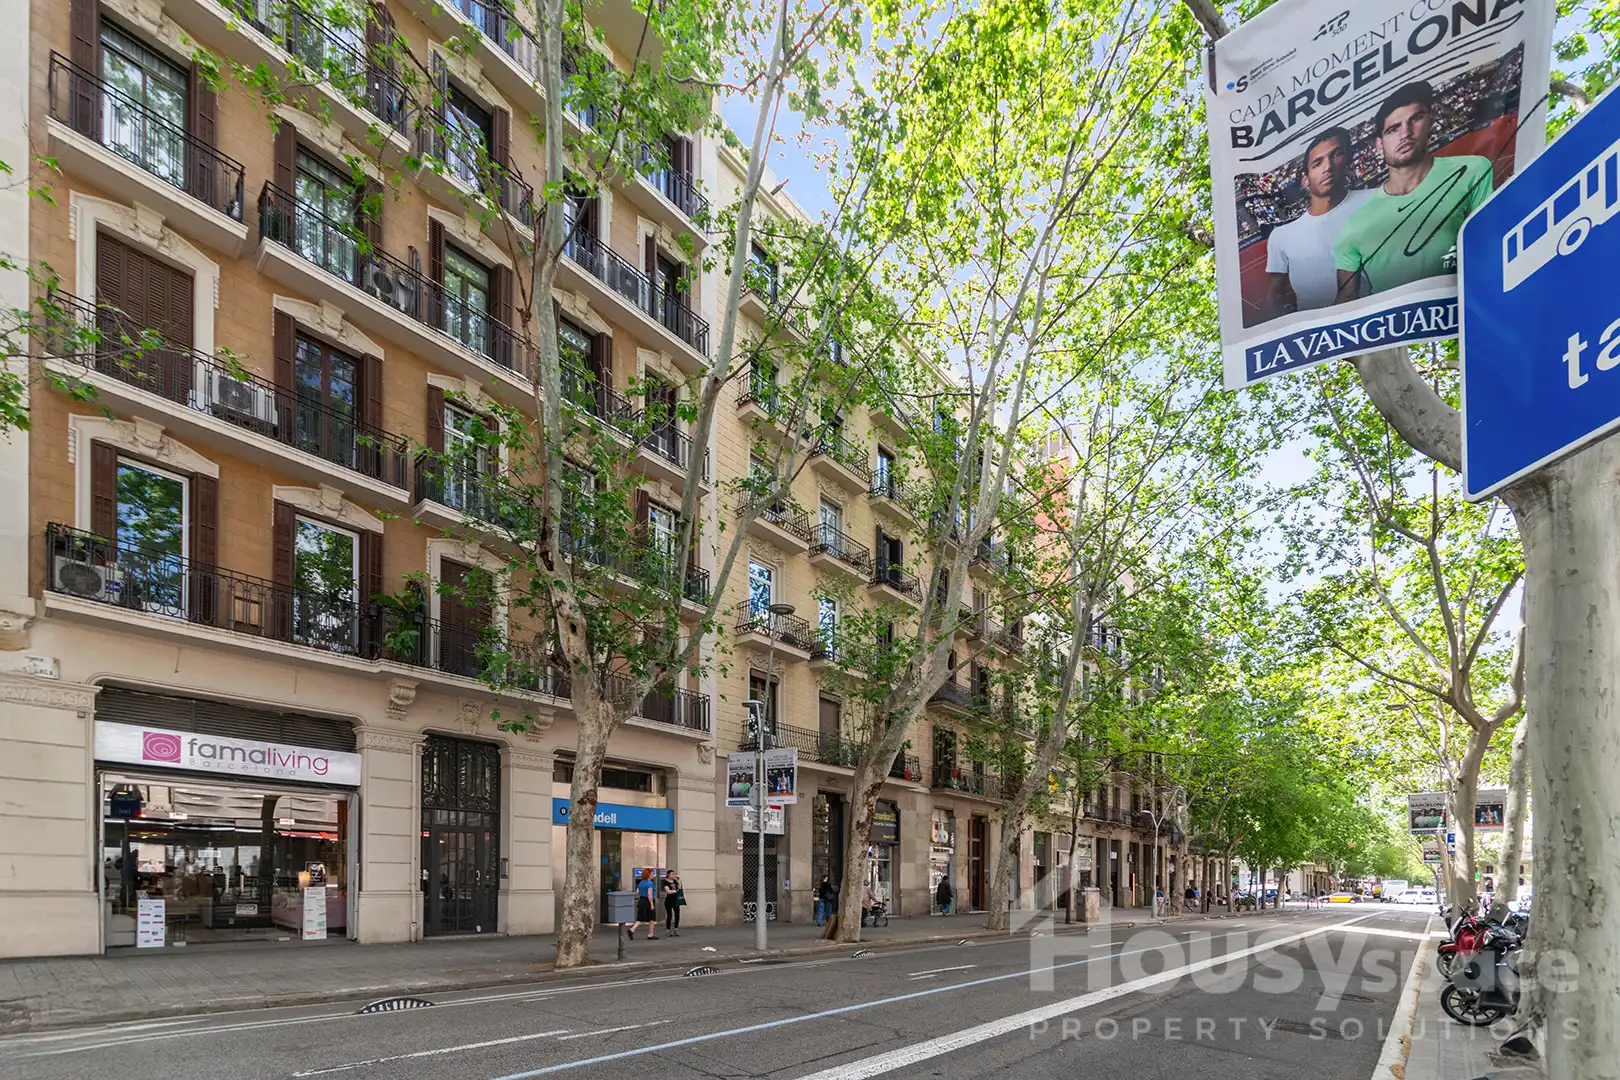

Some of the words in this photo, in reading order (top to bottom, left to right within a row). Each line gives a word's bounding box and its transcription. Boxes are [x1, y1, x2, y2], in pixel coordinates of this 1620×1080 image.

[1310, 9, 1350, 41] ATP
[1332, 23, 1348, 38] 500
[1229, 84, 1286, 124] CADA
[1291, 12, 1405, 87] MOMENT
[1410, 0, 1452, 21] CO
[1253, 341, 1294, 374] LA
[187, 738, 329, 776] famaliving
[189, 758, 297, 776] Barcelona
